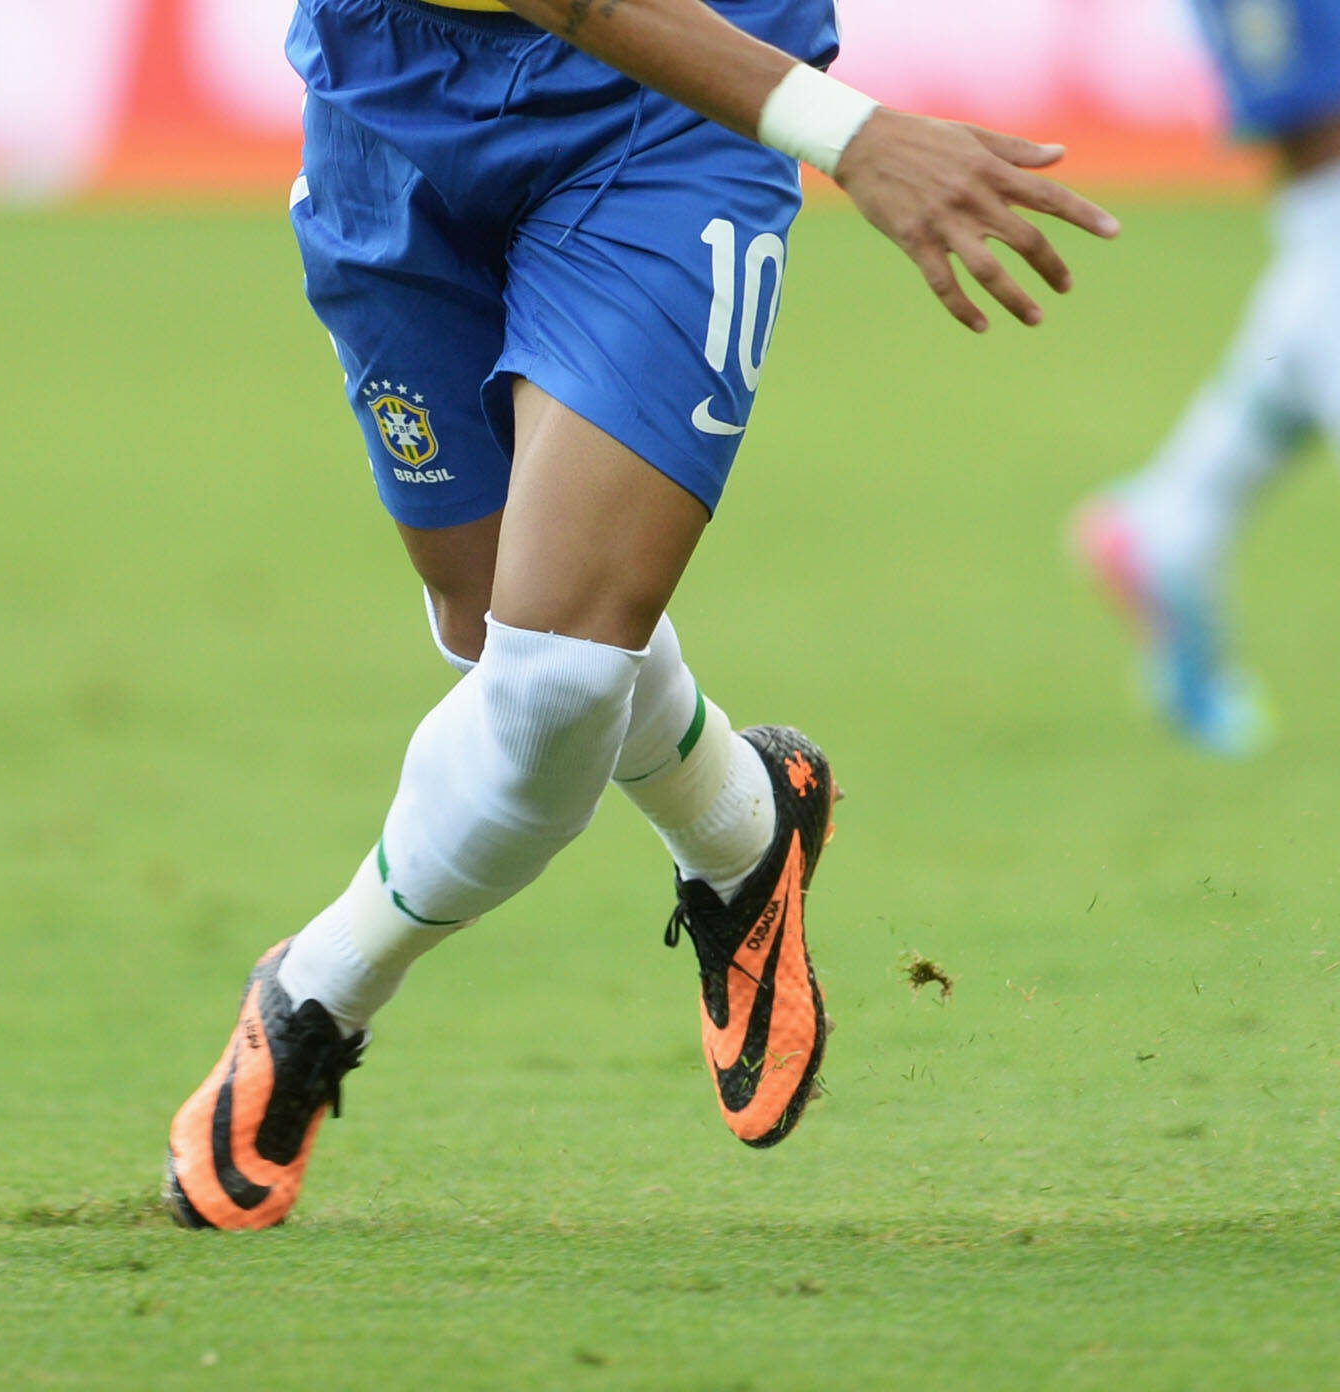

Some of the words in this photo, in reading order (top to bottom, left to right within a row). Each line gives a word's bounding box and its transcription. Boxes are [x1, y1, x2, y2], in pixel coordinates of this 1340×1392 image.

[700, 218, 785, 392] 10
[392, 424, 411, 434] CBF
[393, 468, 456, 483] BRASIL
